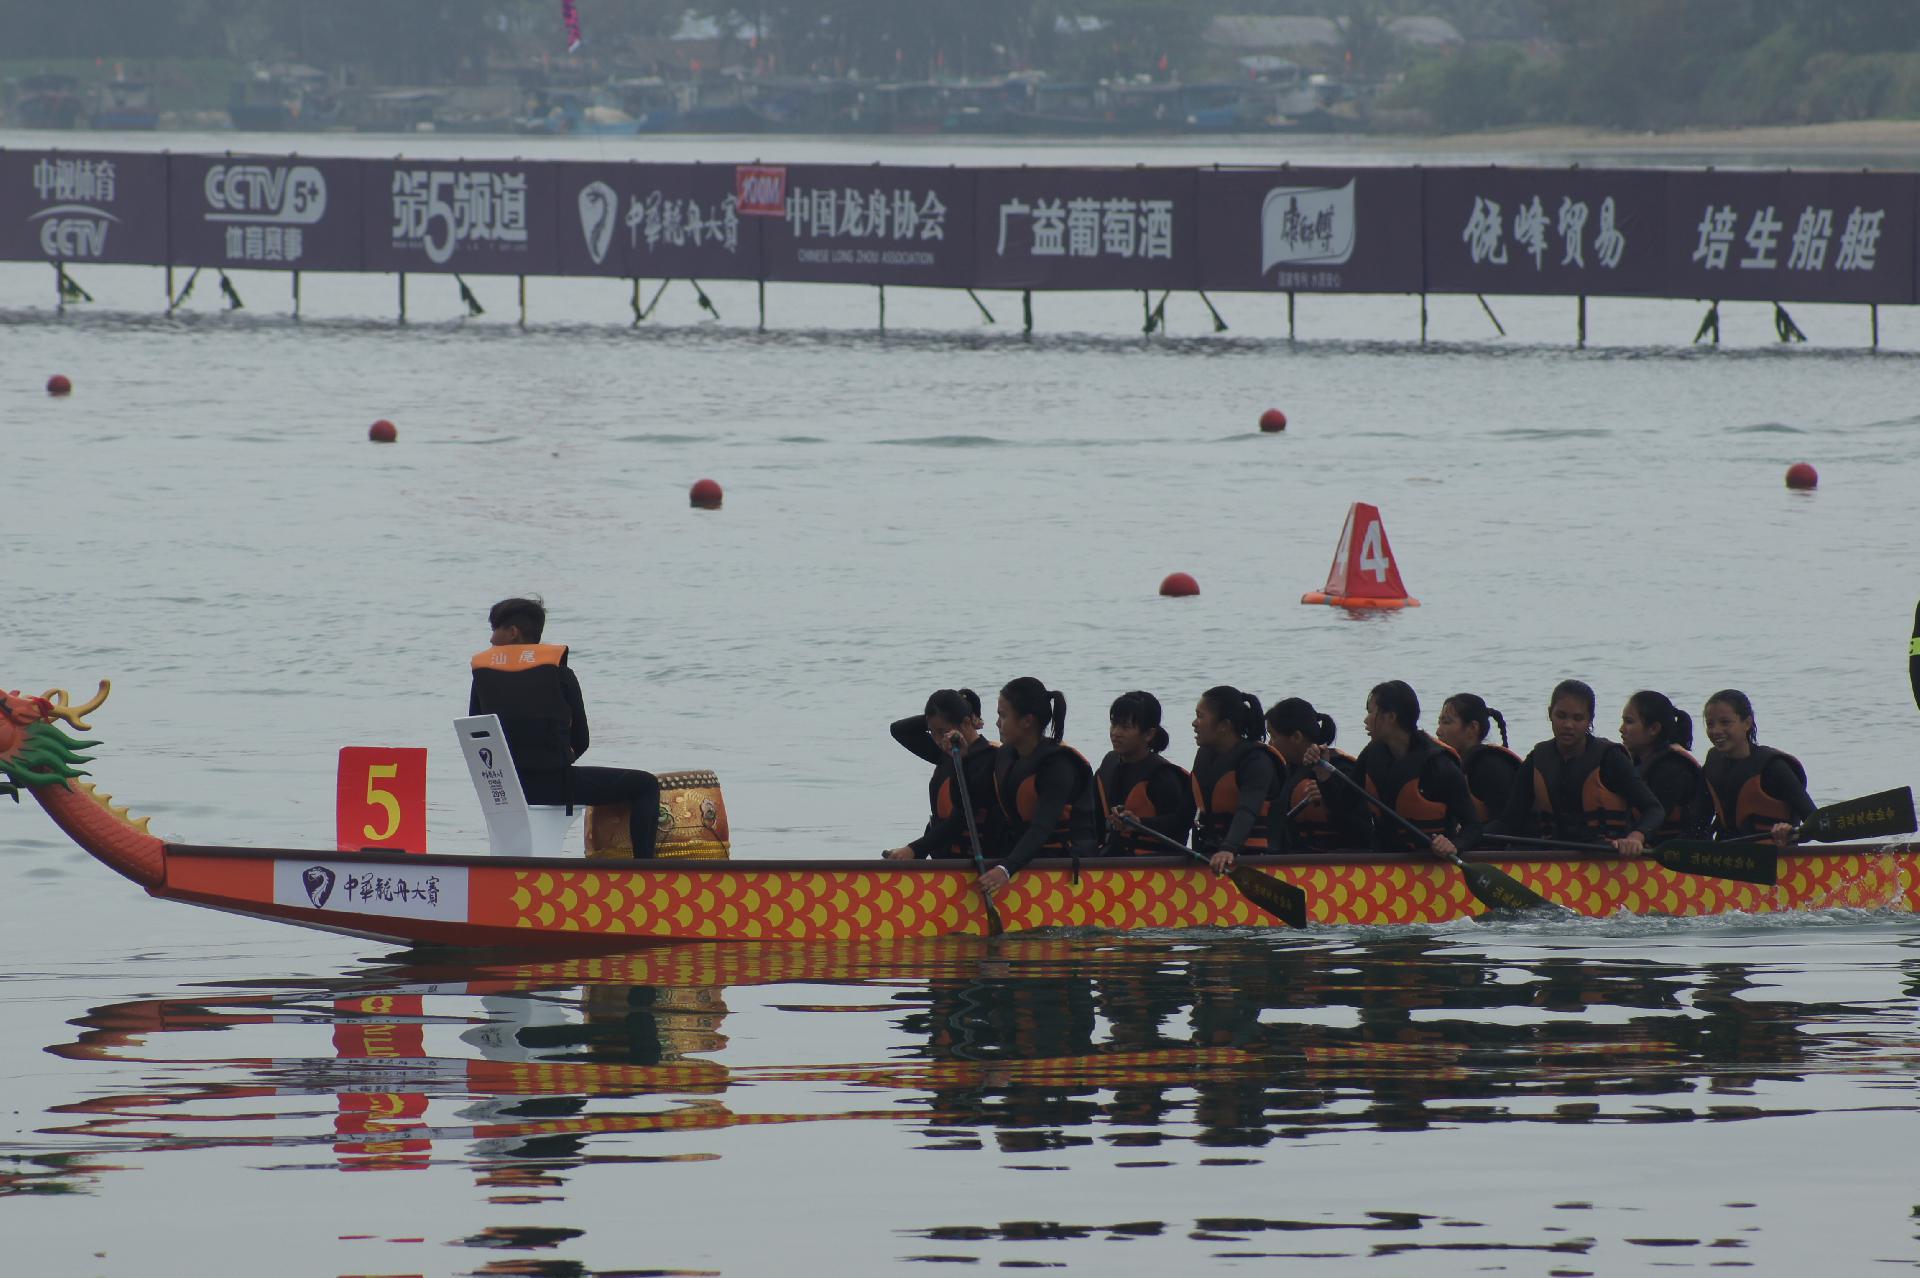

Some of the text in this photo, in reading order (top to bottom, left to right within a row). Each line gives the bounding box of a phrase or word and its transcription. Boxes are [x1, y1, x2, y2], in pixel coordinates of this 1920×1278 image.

[40, 218, 109, 257] CCTV
[391, 170, 528, 264] 第5频道
[786, 187, 947, 240] 中国龙舟协会
[997, 198, 1174, 259] 广益葡萄酒
[1693, 205, 1885, 271] 培生船艇
[1360, 520, 1389, 583] 4
[363, 763, 401, 841] 5
